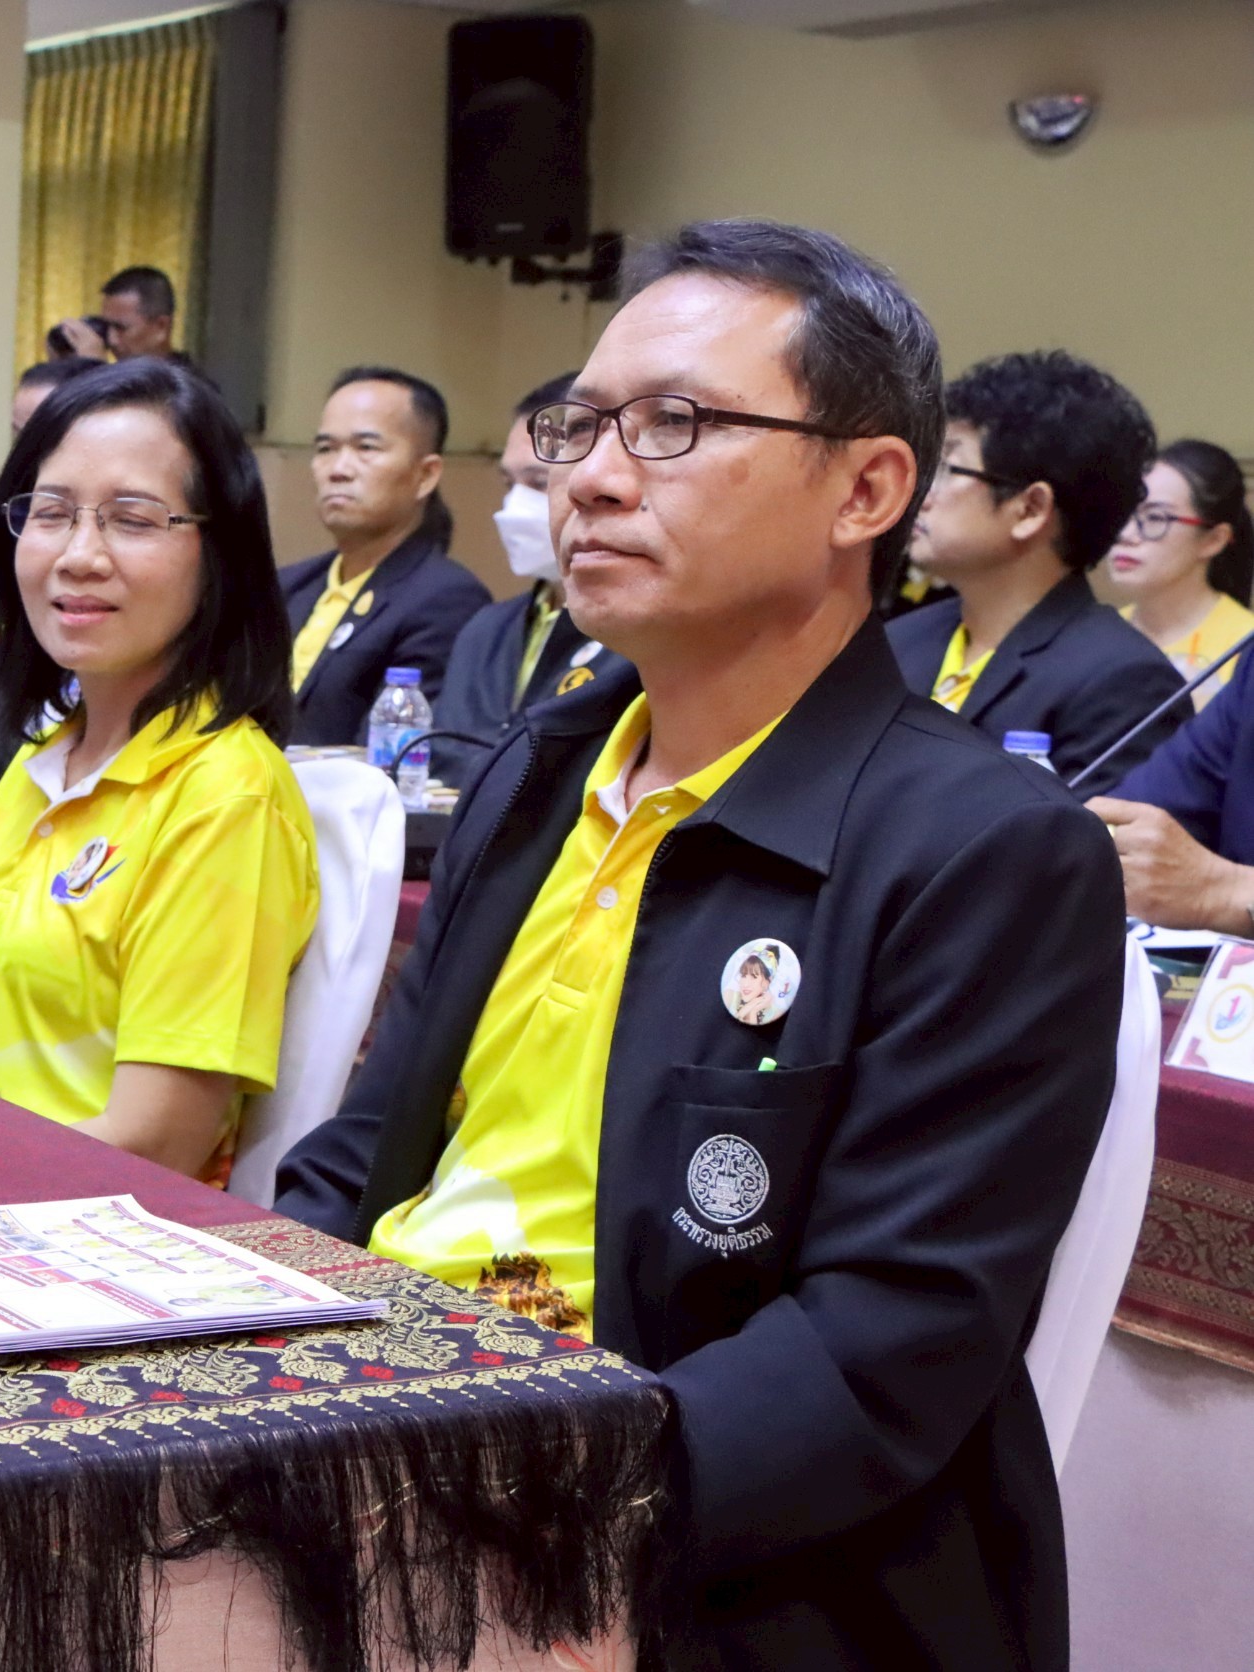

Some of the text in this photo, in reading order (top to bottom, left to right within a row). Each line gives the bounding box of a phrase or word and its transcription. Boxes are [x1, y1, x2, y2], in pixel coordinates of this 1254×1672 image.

[672, 1206, 774, 1259] กระทรวงยุติธรรม
